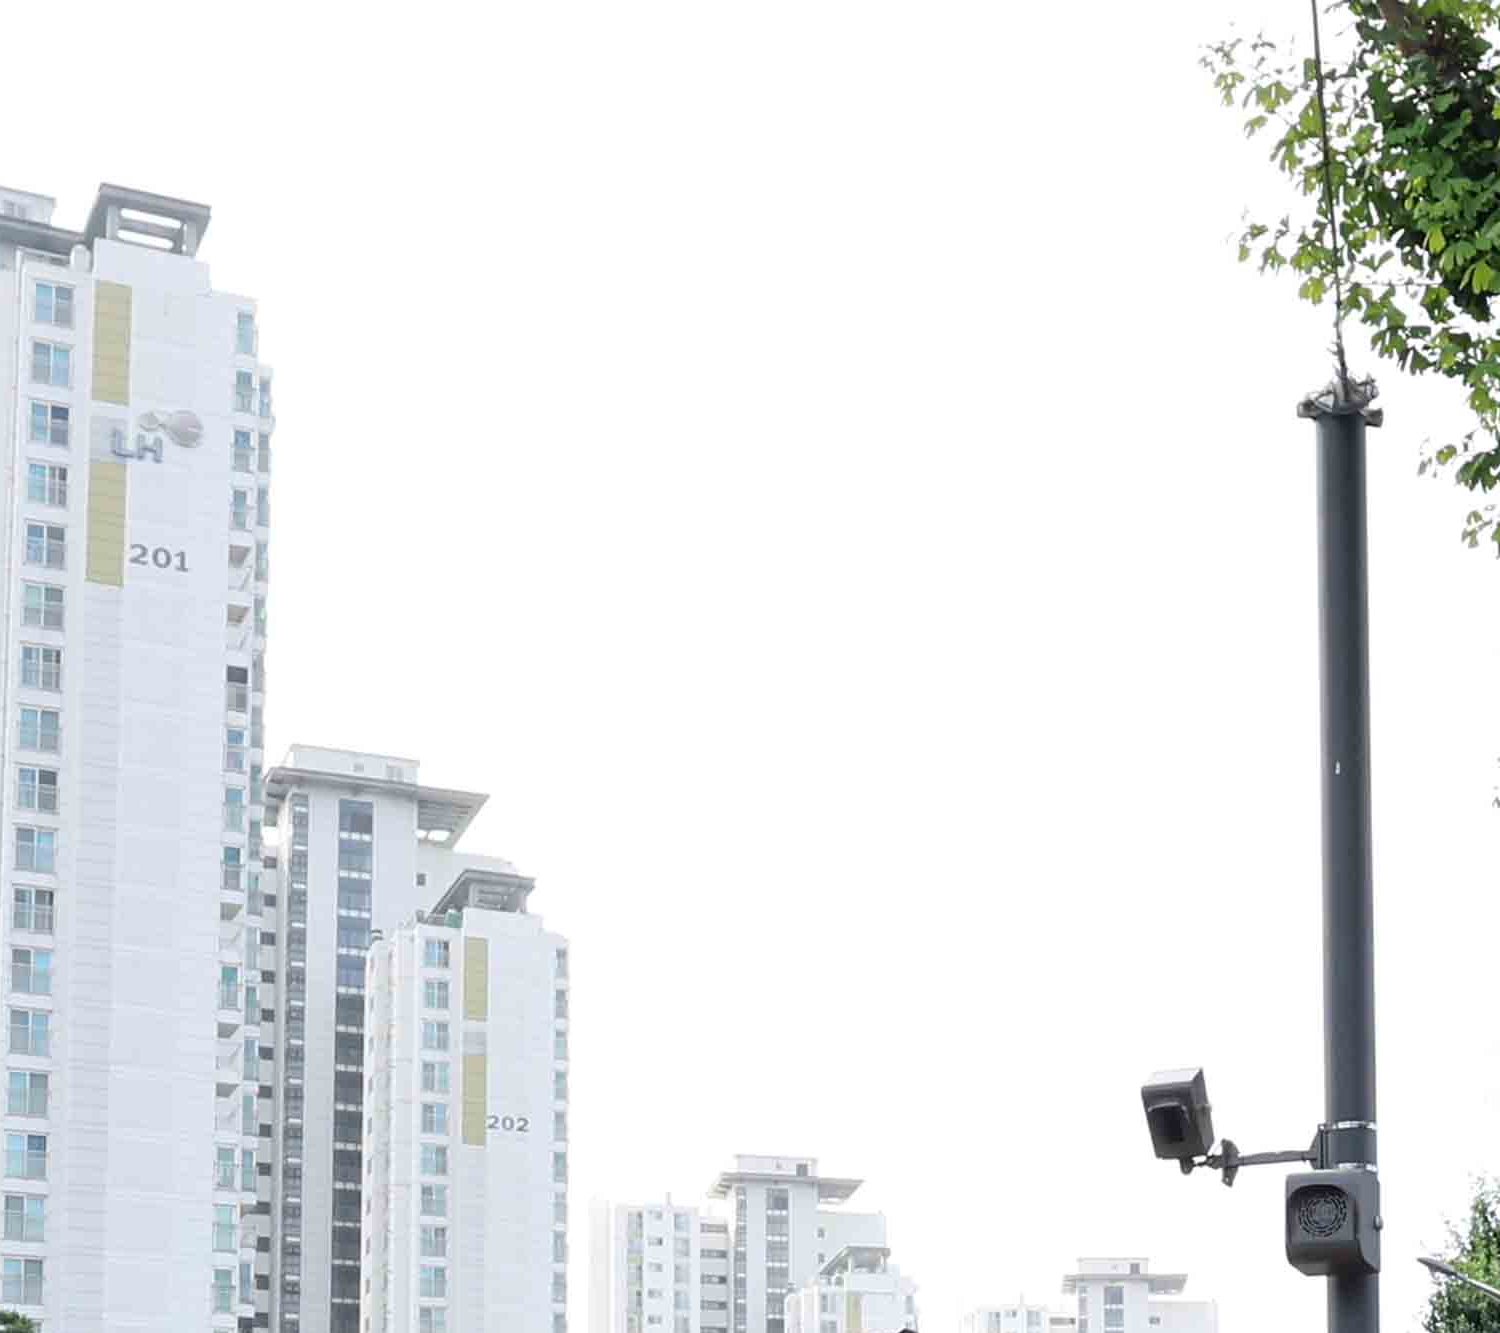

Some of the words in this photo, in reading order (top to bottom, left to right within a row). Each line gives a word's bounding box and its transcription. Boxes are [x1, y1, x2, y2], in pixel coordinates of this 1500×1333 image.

[110, 427, 164, 464] LH
[129, 542, 190, 572] 201
[487, 1115, 529, 1132] 202
